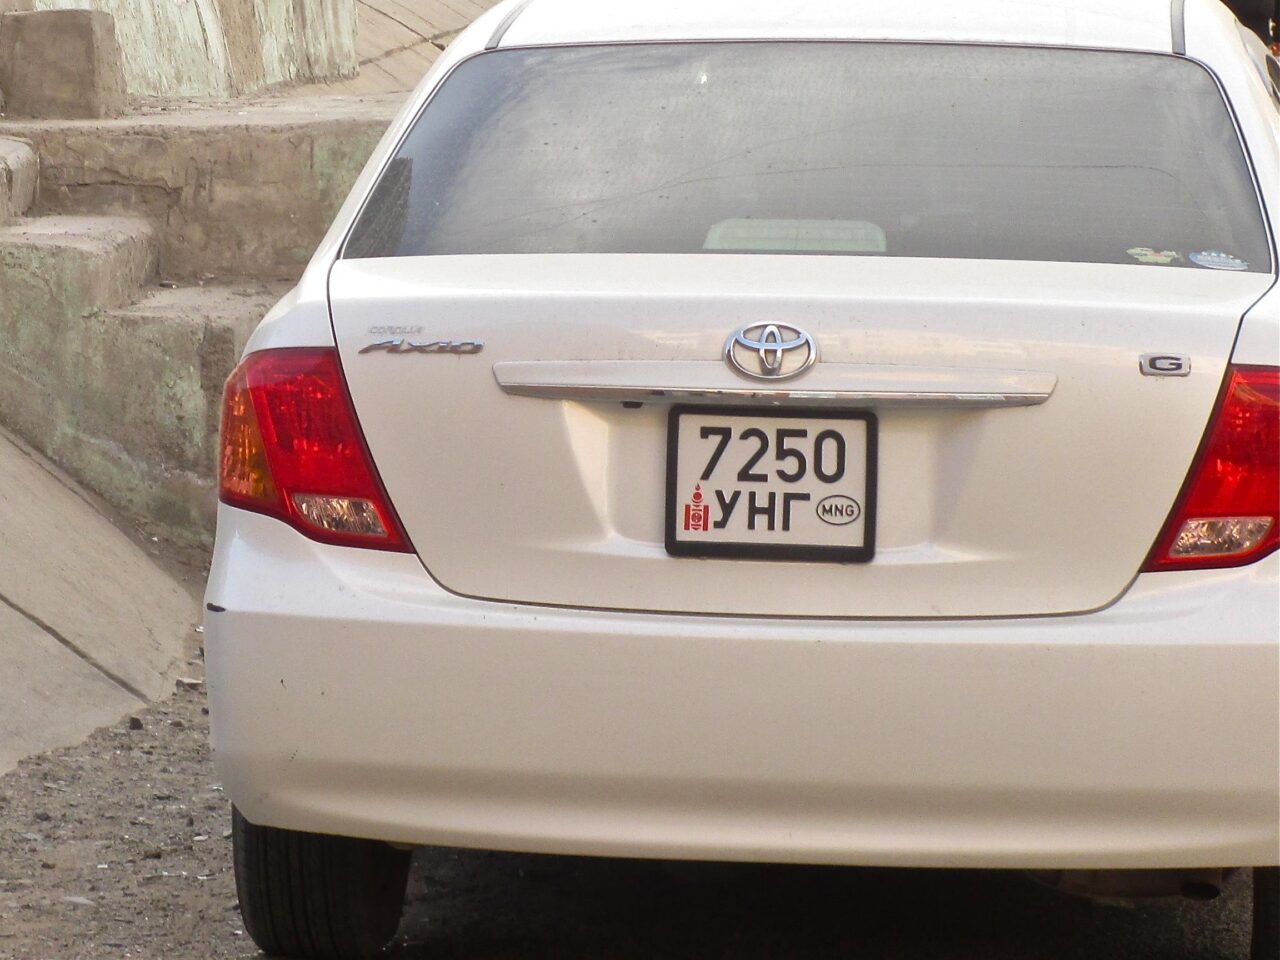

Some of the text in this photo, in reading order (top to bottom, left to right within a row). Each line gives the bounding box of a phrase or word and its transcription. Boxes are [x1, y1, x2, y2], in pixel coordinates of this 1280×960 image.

[1149, 356, 1183, 371] G
[699, 426, 846, 484] 7250
[713, 489, 855, 532] УНГ MNG
